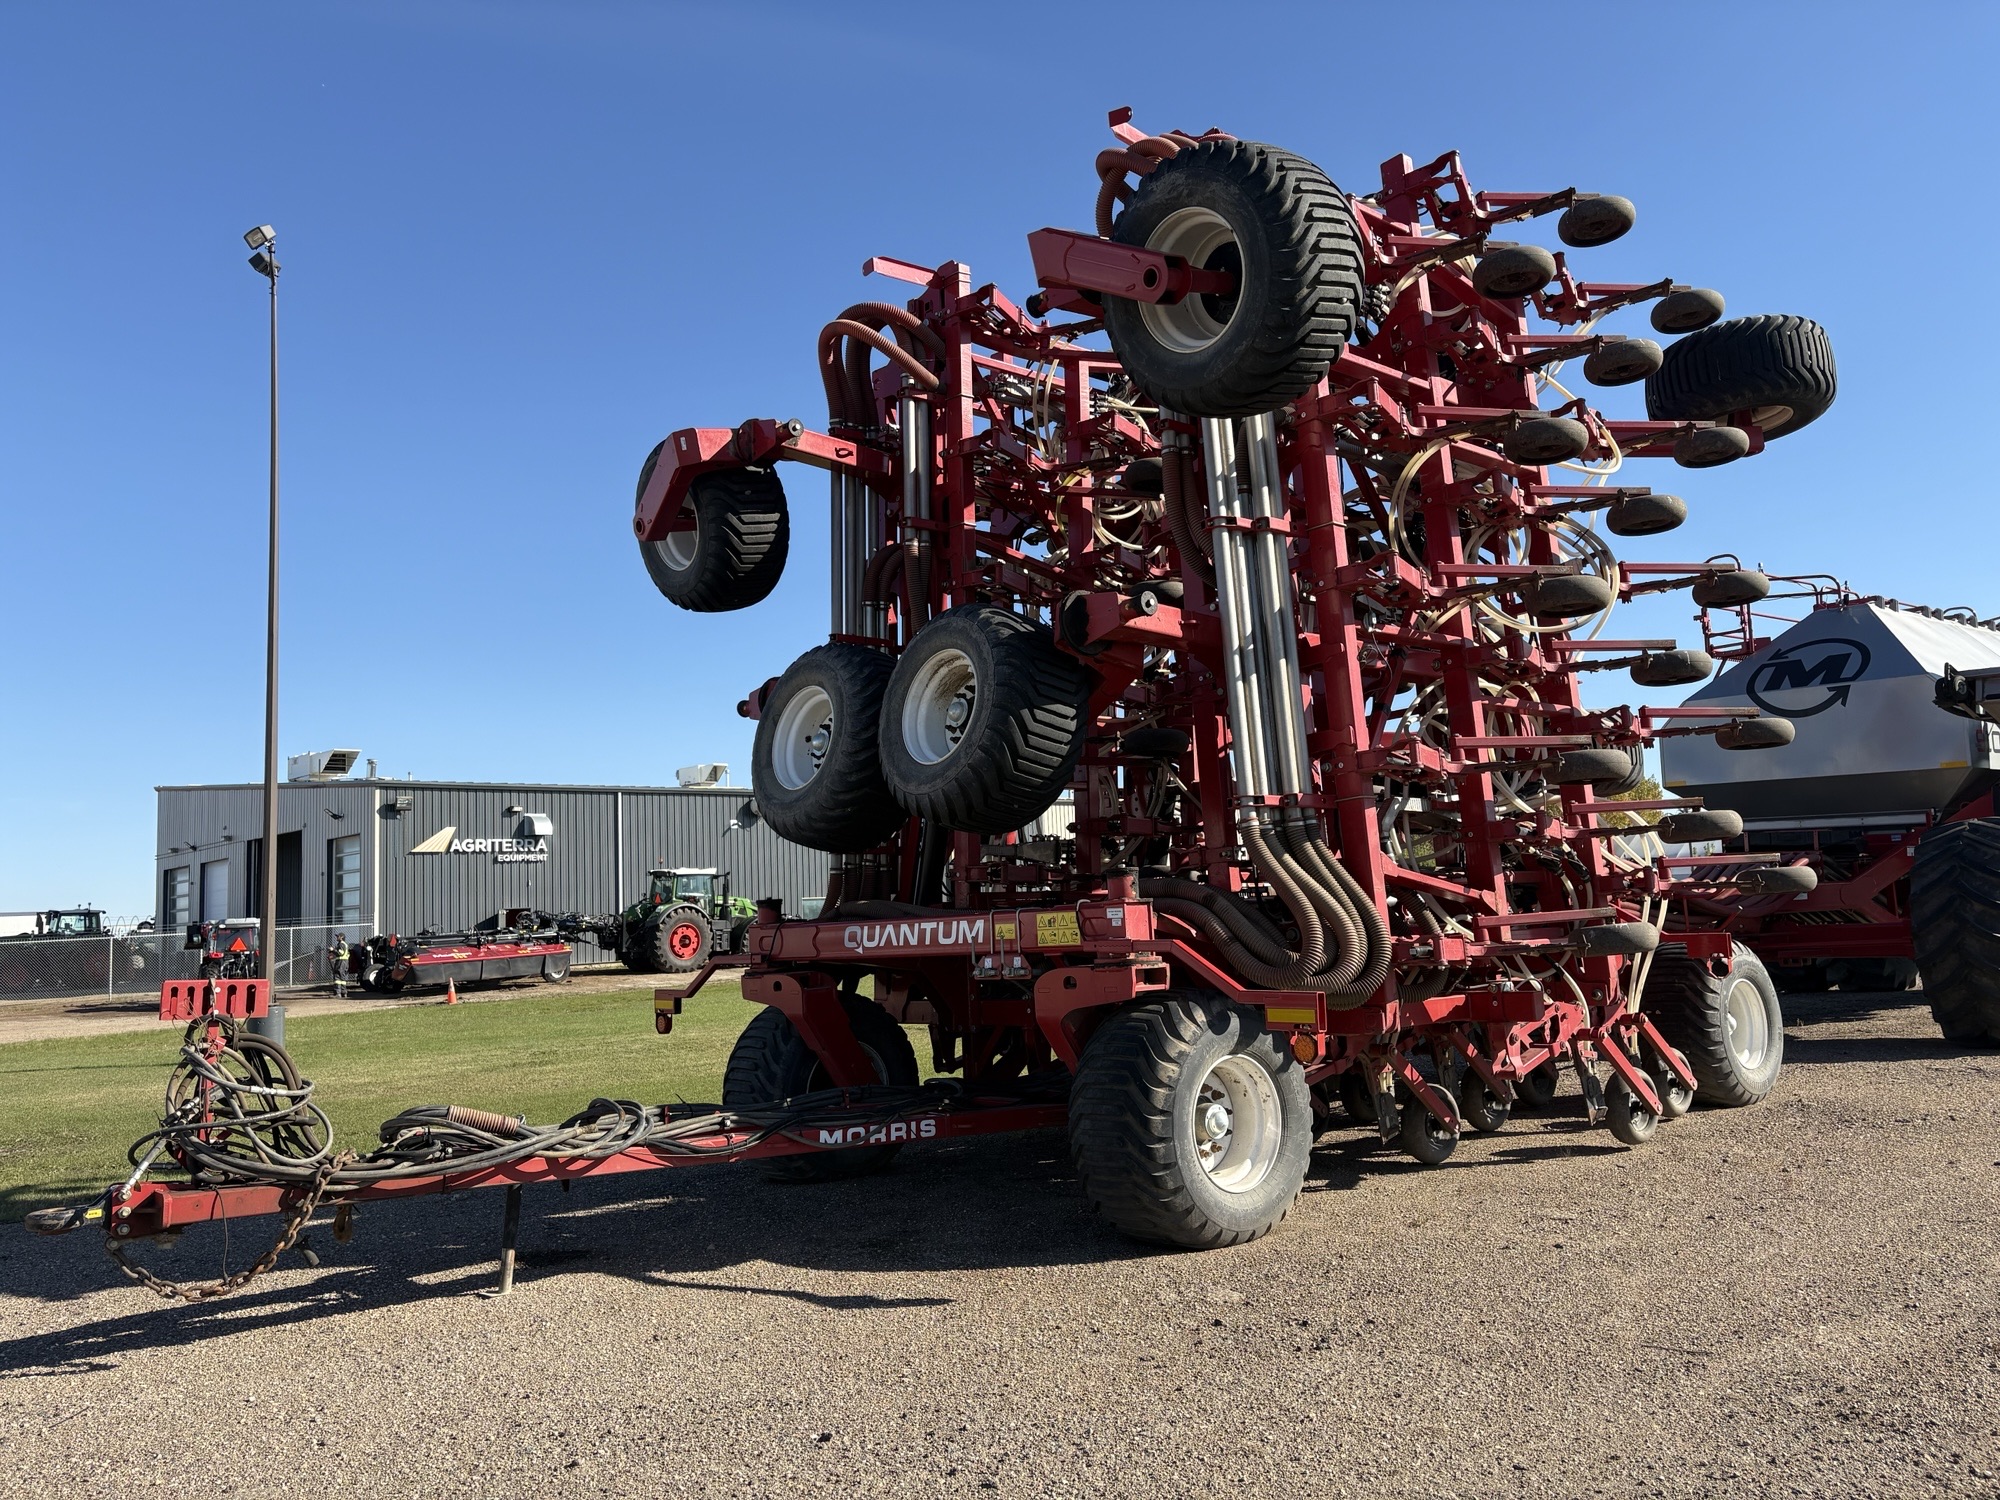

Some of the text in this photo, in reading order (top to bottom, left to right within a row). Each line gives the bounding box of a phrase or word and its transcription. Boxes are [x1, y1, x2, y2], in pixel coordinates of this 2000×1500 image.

[450, 838, 549, 852] AGRITERRA
[497, 853, 549, 862] EQUIPMENT
[843, 919, 985, 954] QUANTUM
[819, 1119, 937, 1145] MORRIS
